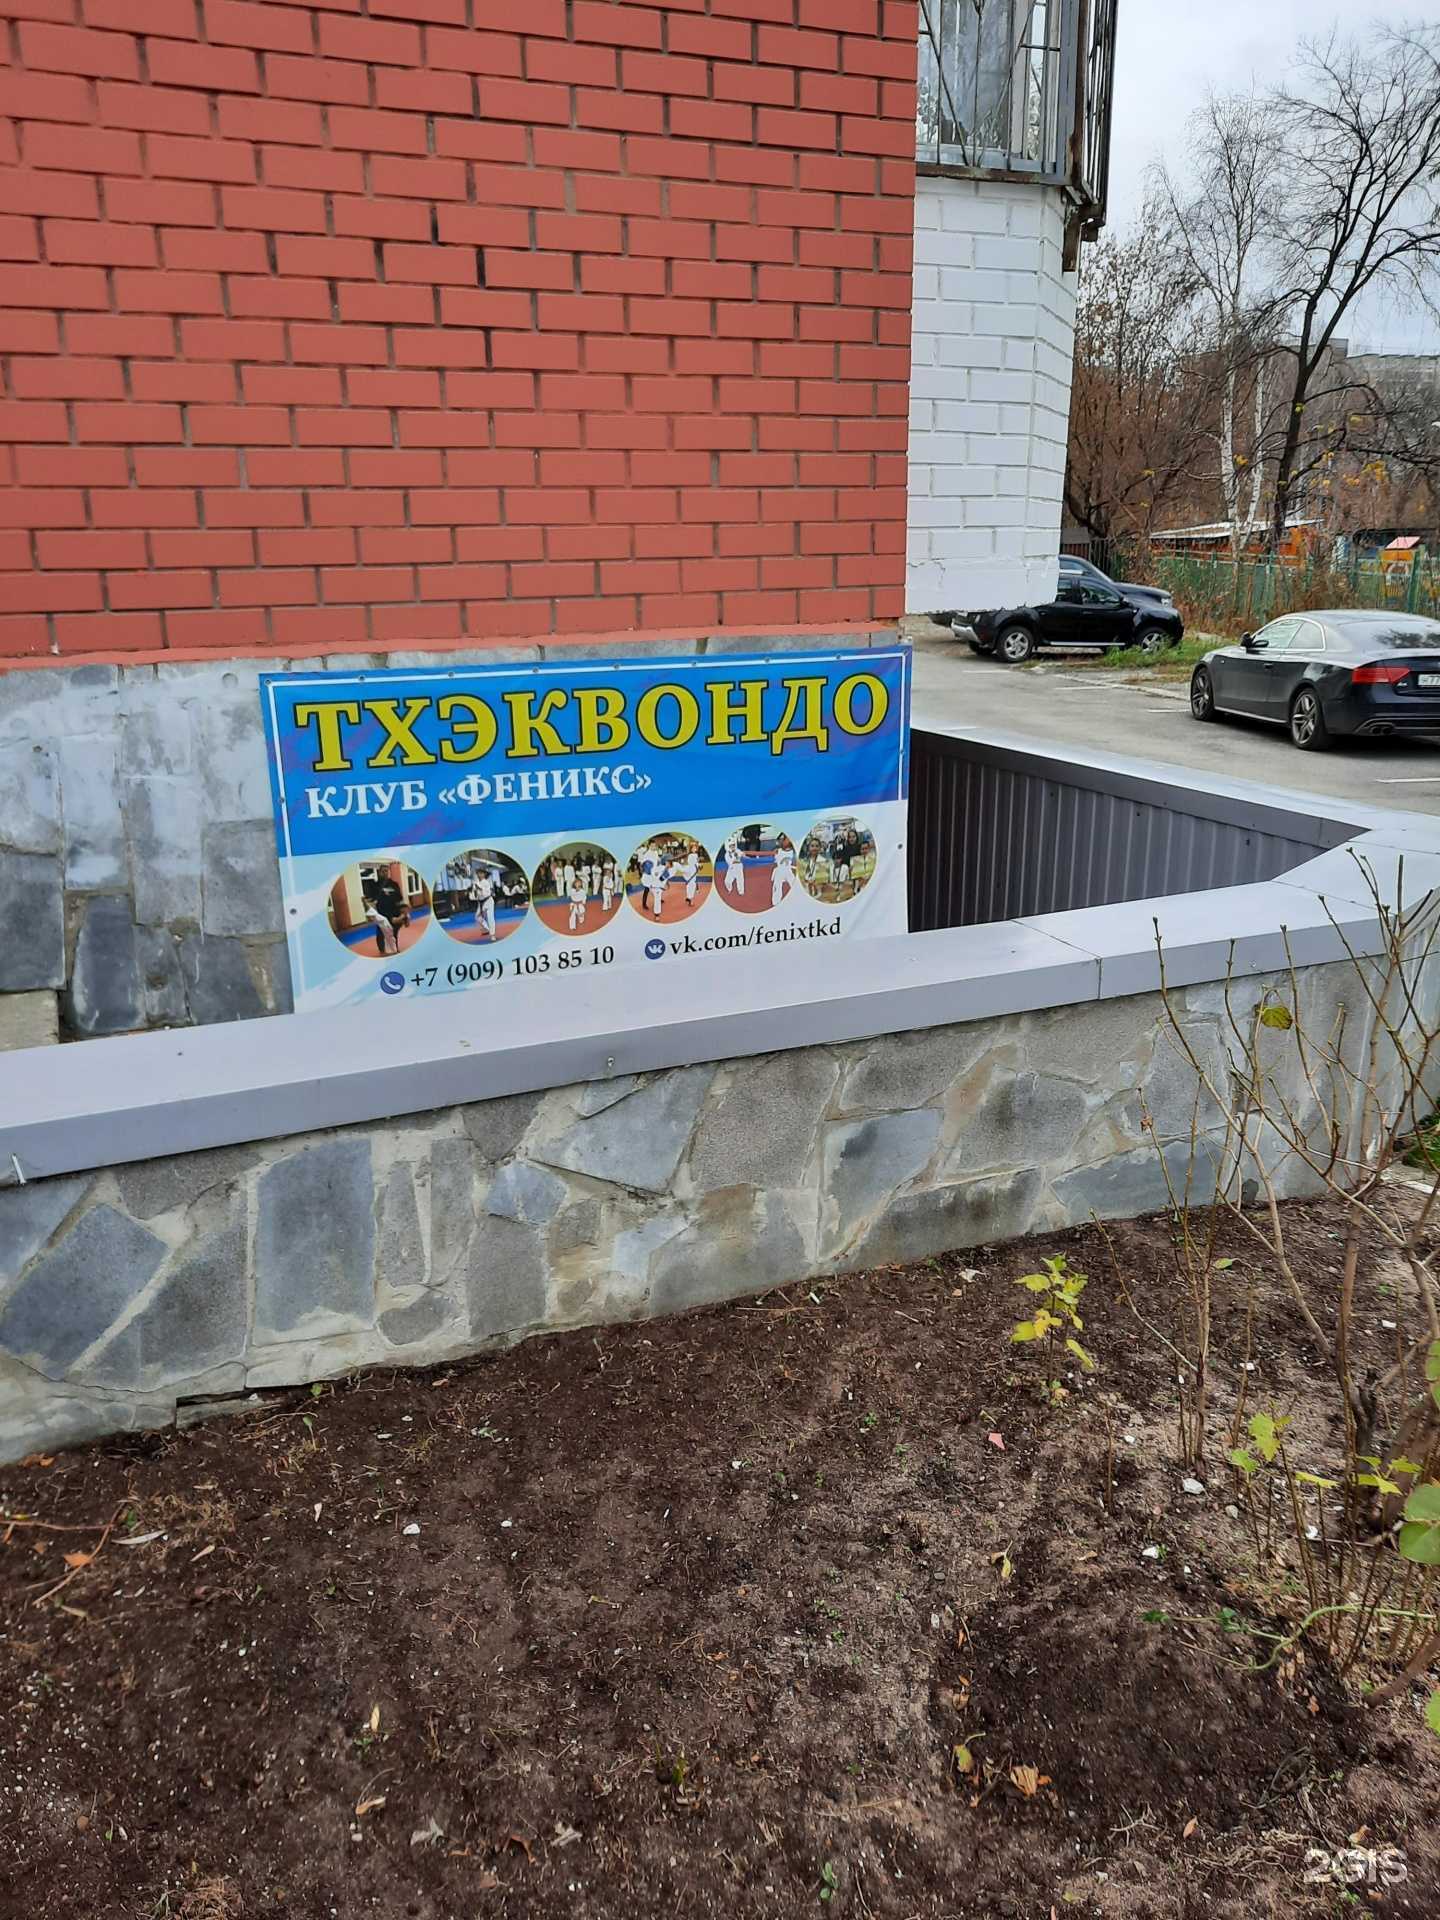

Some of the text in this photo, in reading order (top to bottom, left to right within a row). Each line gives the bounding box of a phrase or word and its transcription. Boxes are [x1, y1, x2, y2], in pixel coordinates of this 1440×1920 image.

[296, 673, 888, 771] ТХЭКВОНДО
[304, 765, 652, 818] КЛУБ «ФЕНИКС»
[670, 917, 841, 954] vk.com/fenixtkd
[411, 946, 614, 987] +7 (909) 103 85 10
